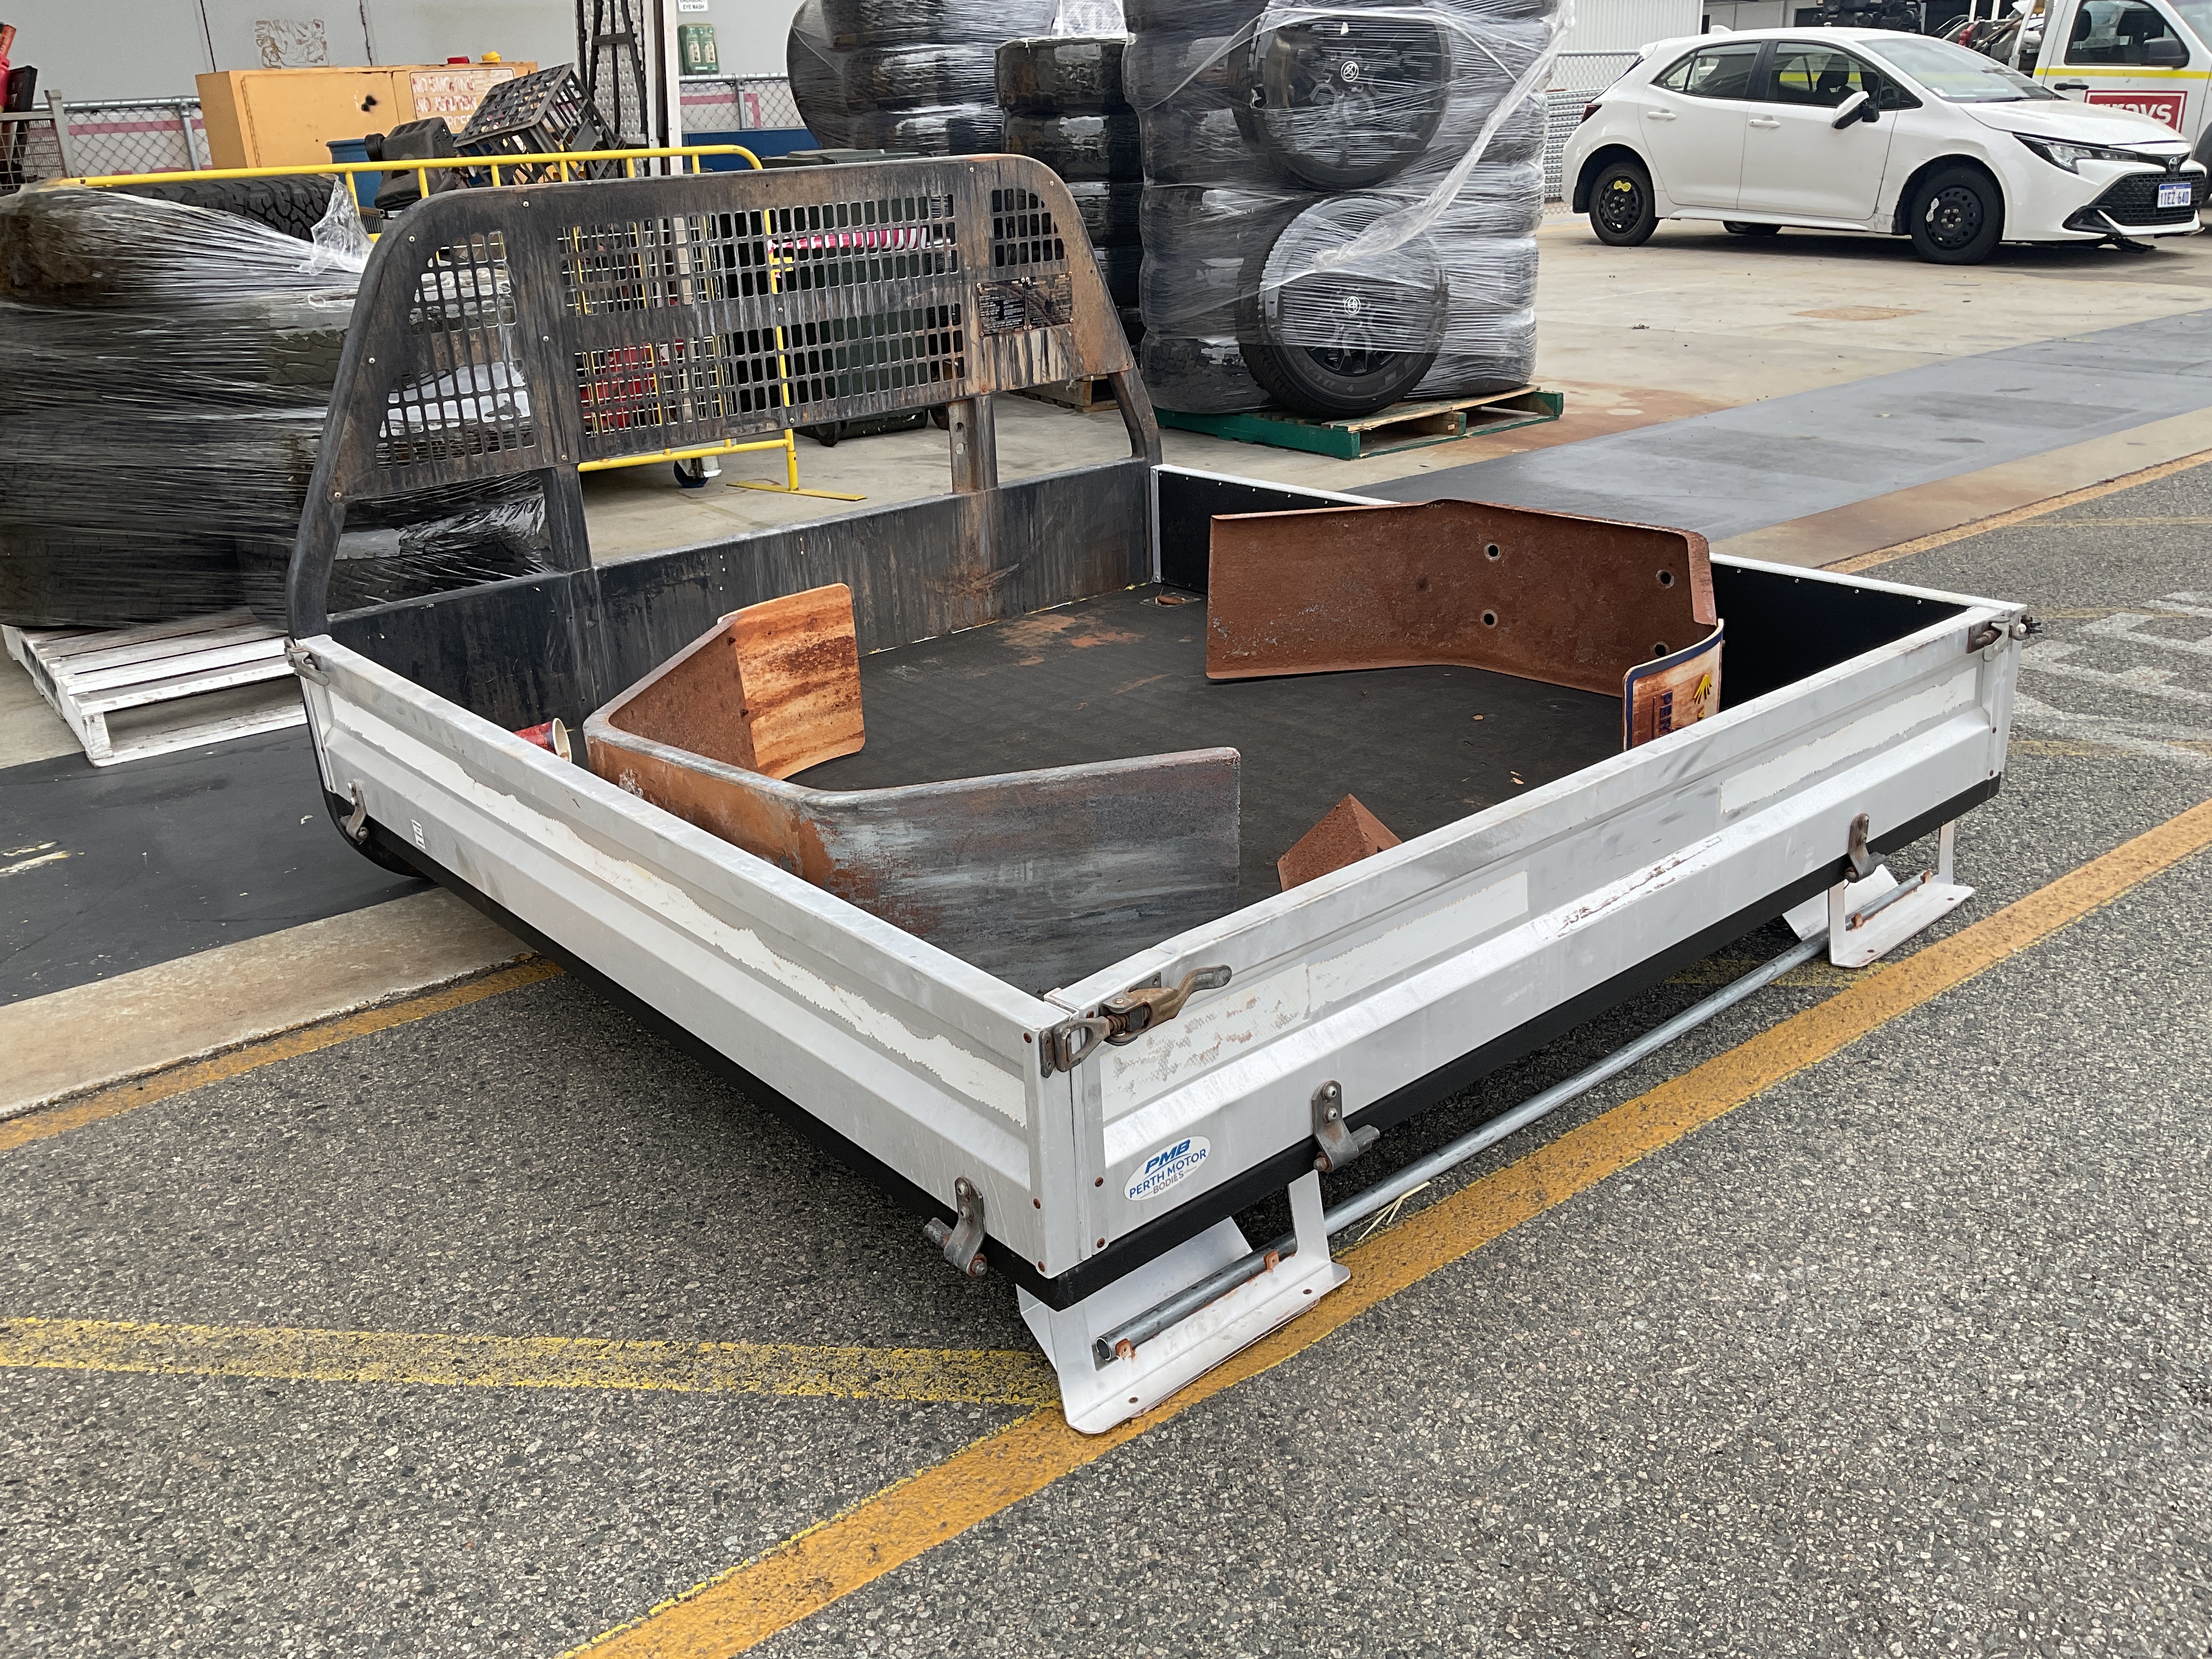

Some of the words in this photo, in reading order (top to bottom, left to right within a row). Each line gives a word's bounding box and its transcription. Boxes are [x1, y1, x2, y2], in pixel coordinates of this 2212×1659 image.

[412, 77, 427, 93] NO
[416, 97, 431, 112] NO
[1144, 1139, 1190, 1175] PMB
[1130, 1170, 1165, 1198] PERTH
[1167, 1148, 1206, 1176] MOTOR
[1153, 1170, 1184, 1194] BODIES
